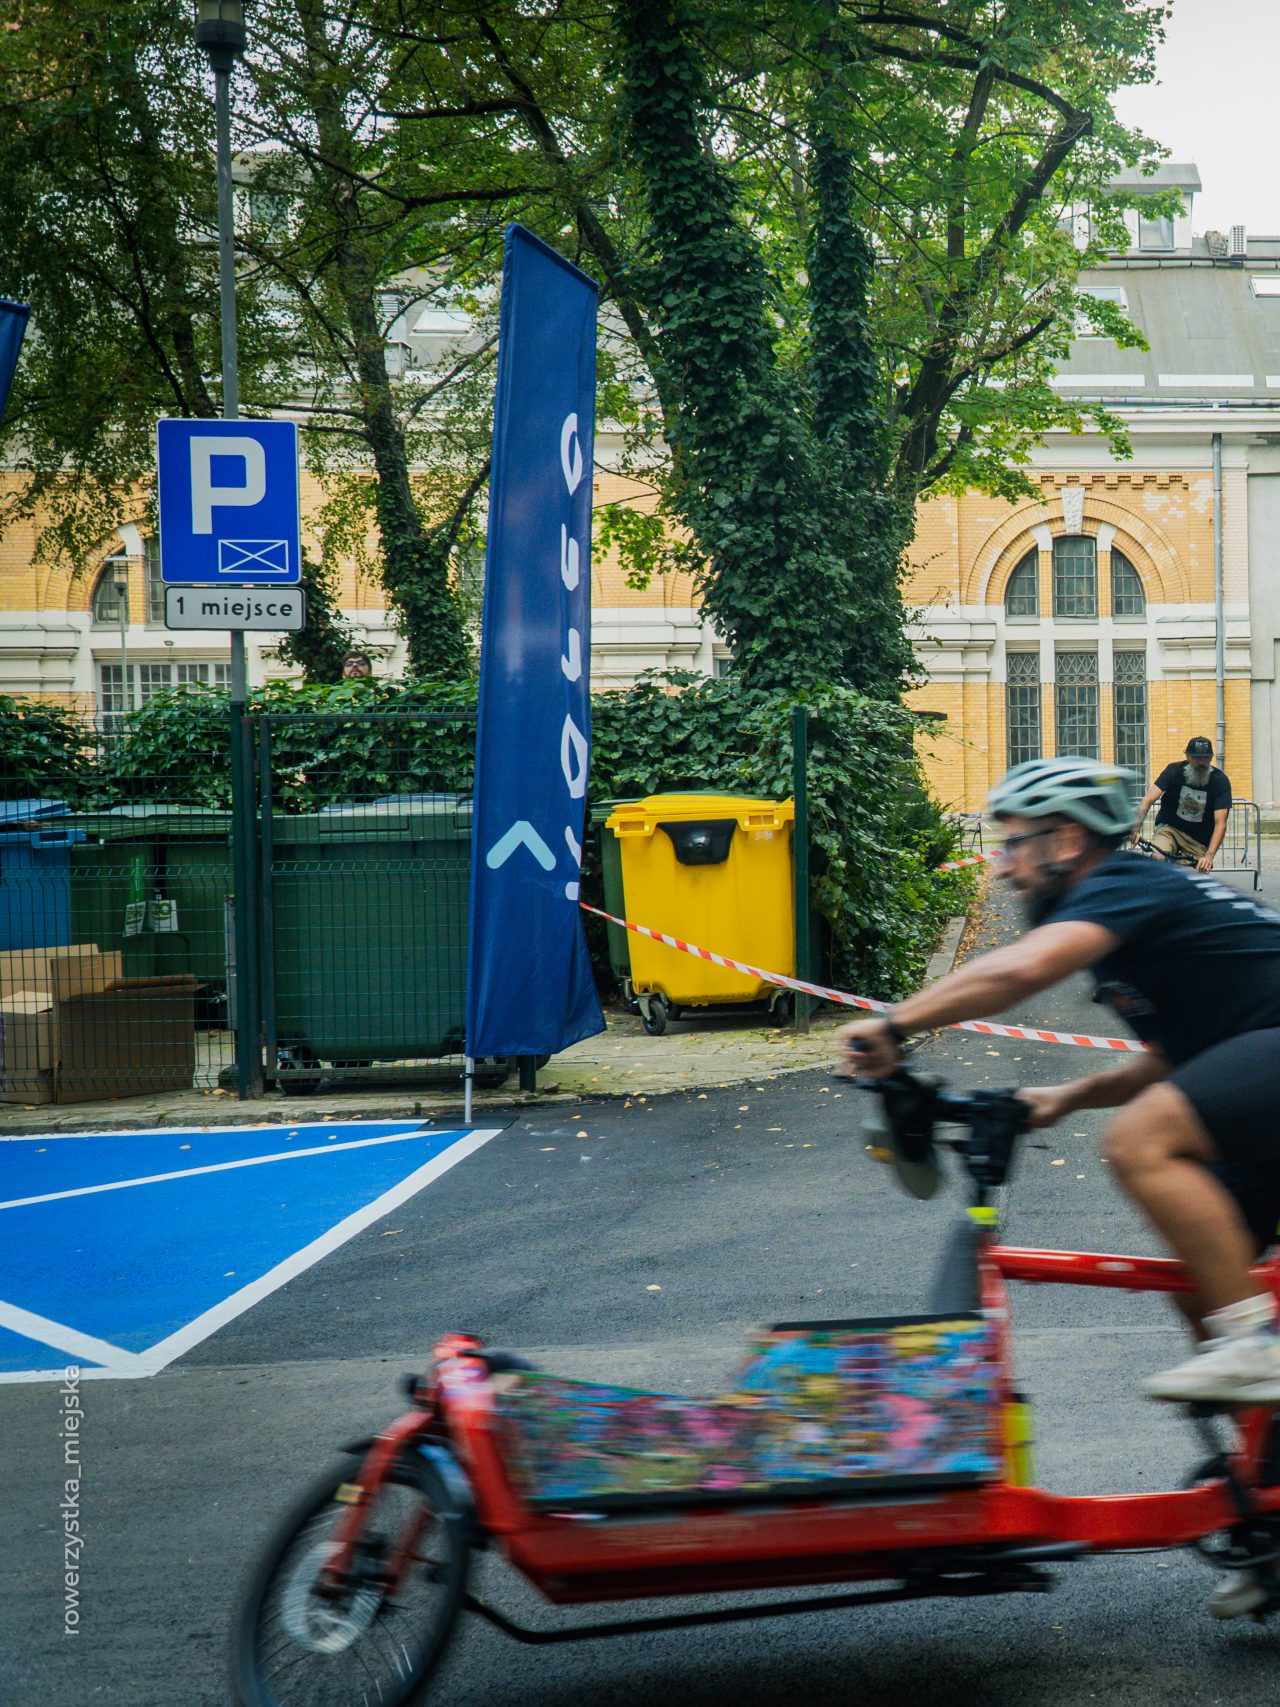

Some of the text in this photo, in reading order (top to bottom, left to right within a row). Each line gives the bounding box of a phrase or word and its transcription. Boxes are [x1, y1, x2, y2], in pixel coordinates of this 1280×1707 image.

[190, 435, 266, 535] P
[176, 596, 293, 621] 1 miejsce
